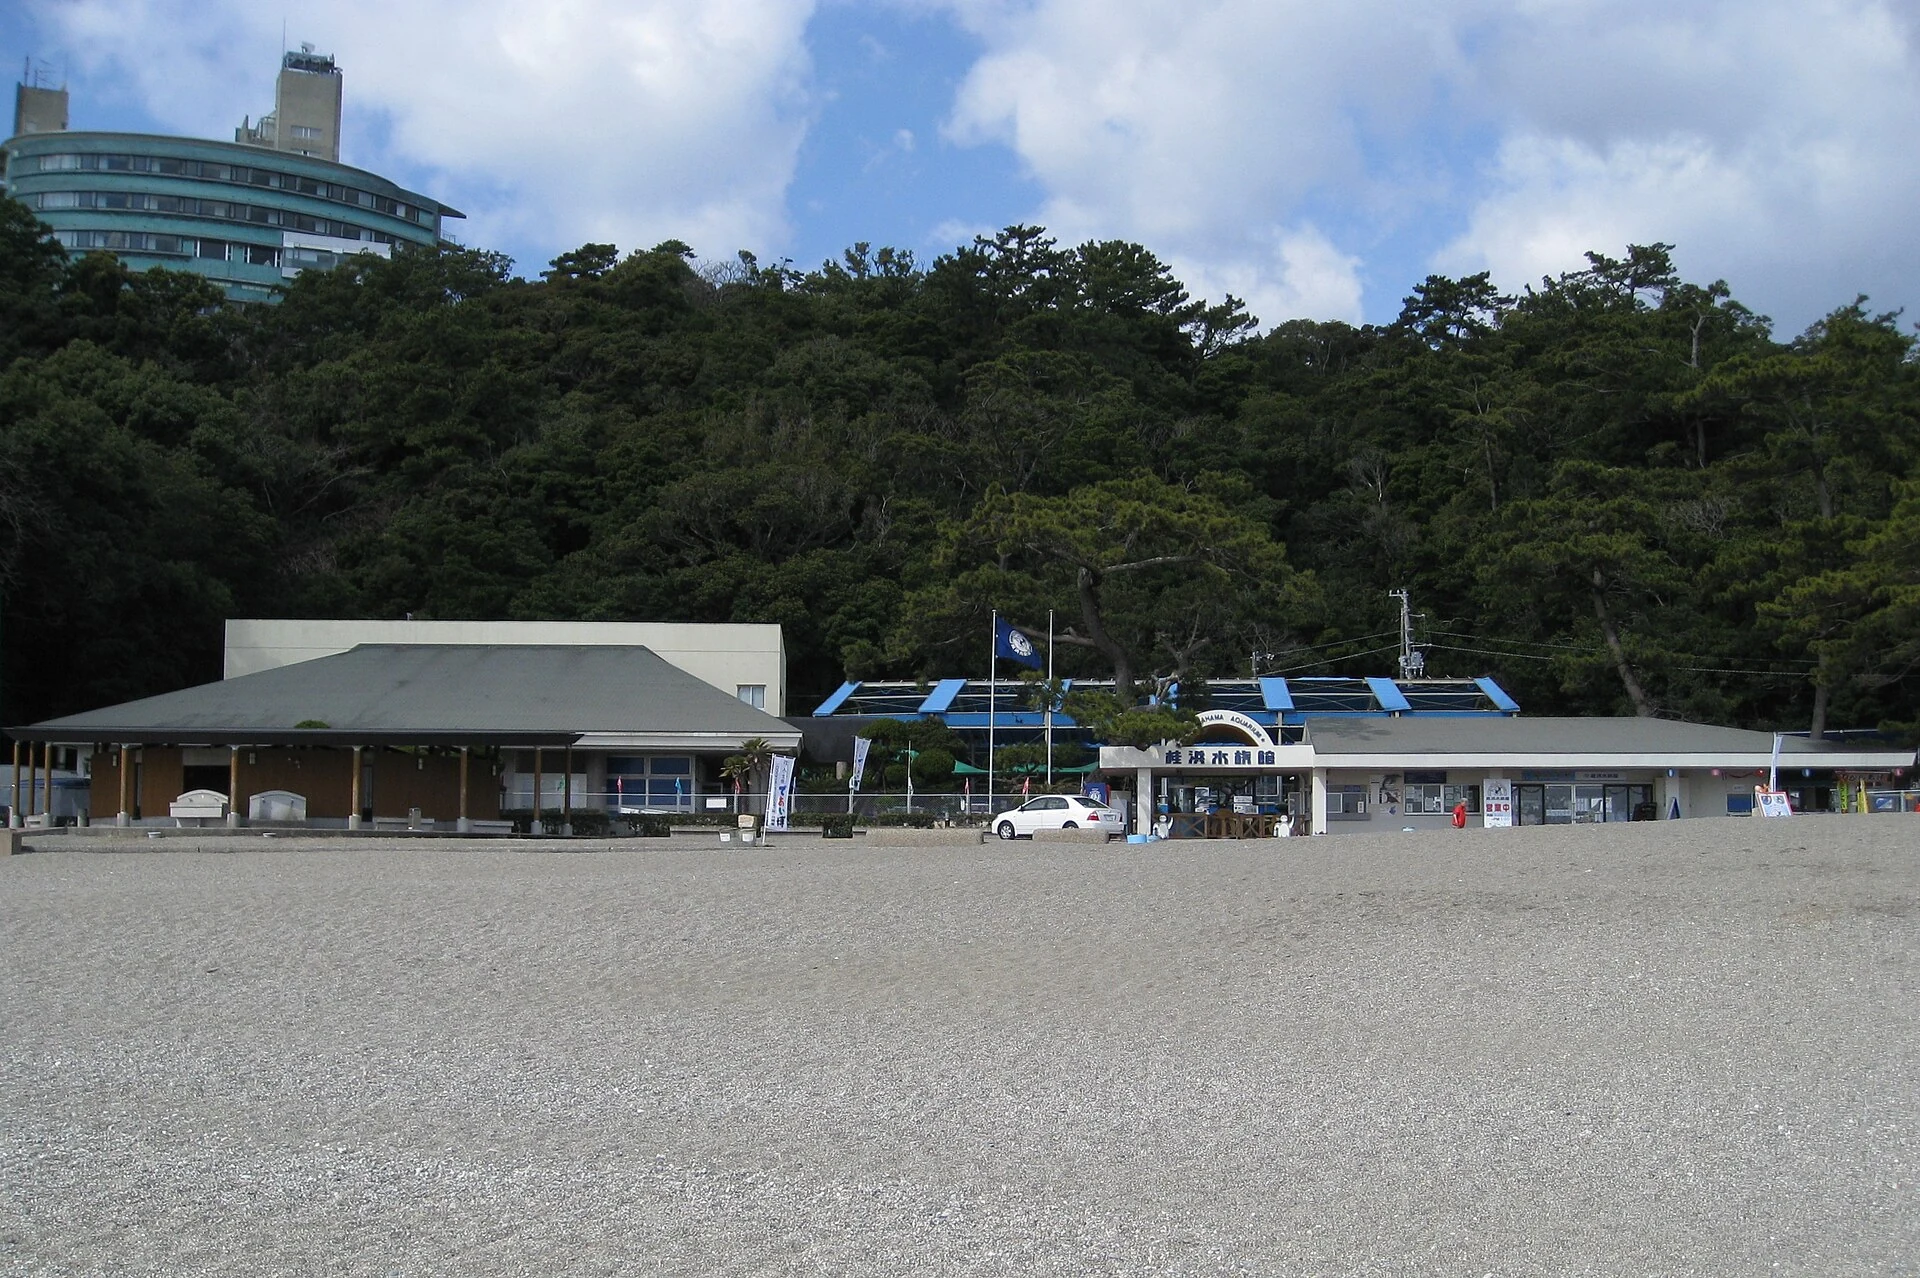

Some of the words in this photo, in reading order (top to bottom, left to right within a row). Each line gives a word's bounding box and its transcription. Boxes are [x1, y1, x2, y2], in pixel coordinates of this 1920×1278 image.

[1230, 715, 1263, 739] AQUARIUM
[1166, 751, 1275, 765] 桂浜水族館
[1486, 803, 1510, 812] 営業中
